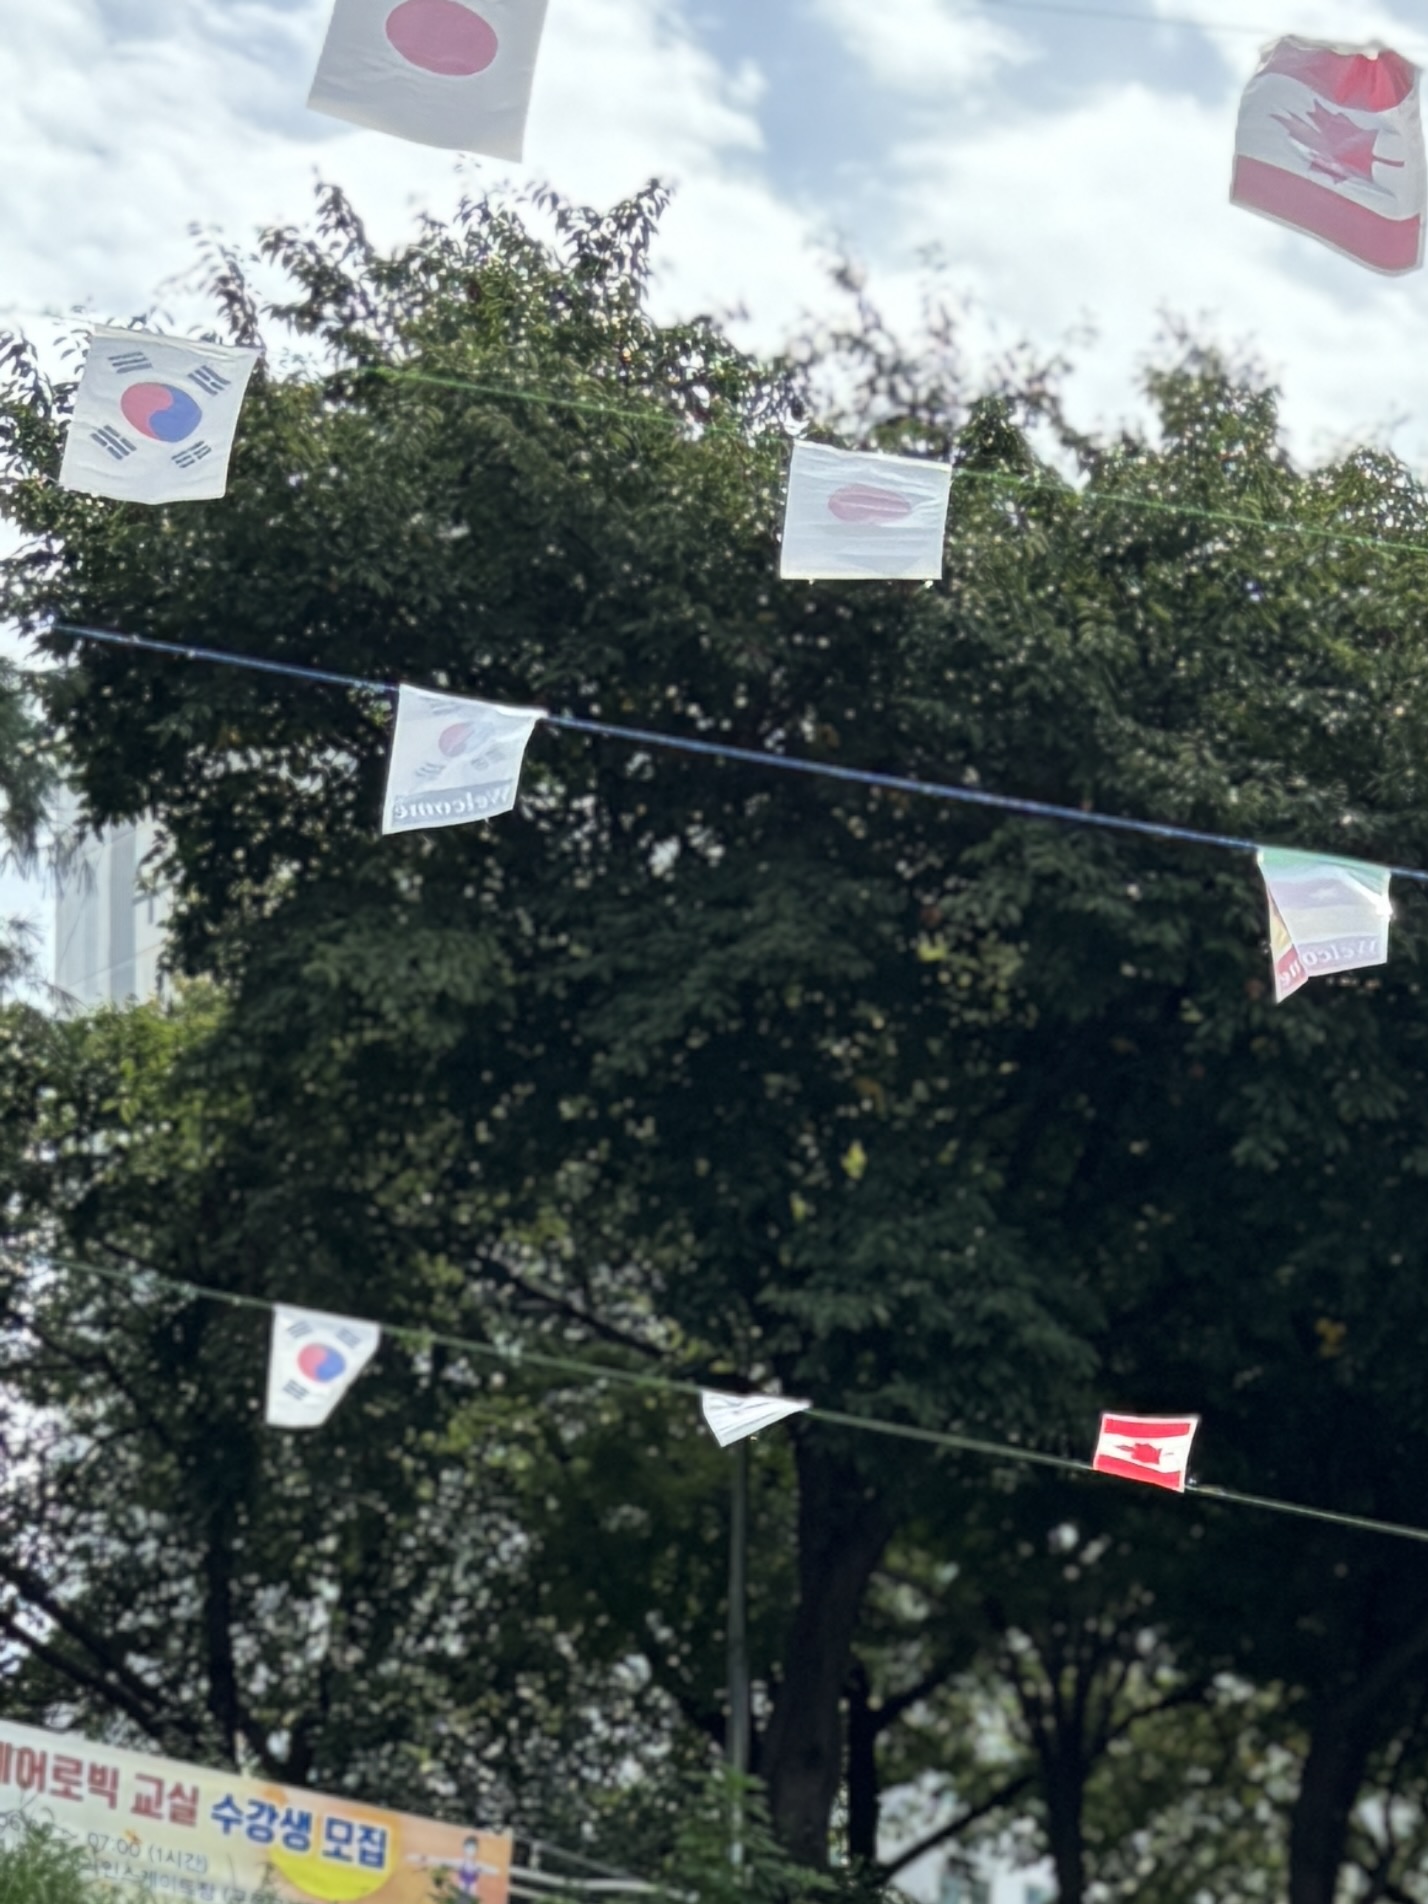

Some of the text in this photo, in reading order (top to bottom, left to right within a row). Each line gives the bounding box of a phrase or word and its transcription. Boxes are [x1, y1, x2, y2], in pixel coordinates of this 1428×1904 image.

[131, 1772, 200, 1828] 교실
[210, 1792, 313, 1853] 수강생
[321, 1815, 390, 1870] 모집
